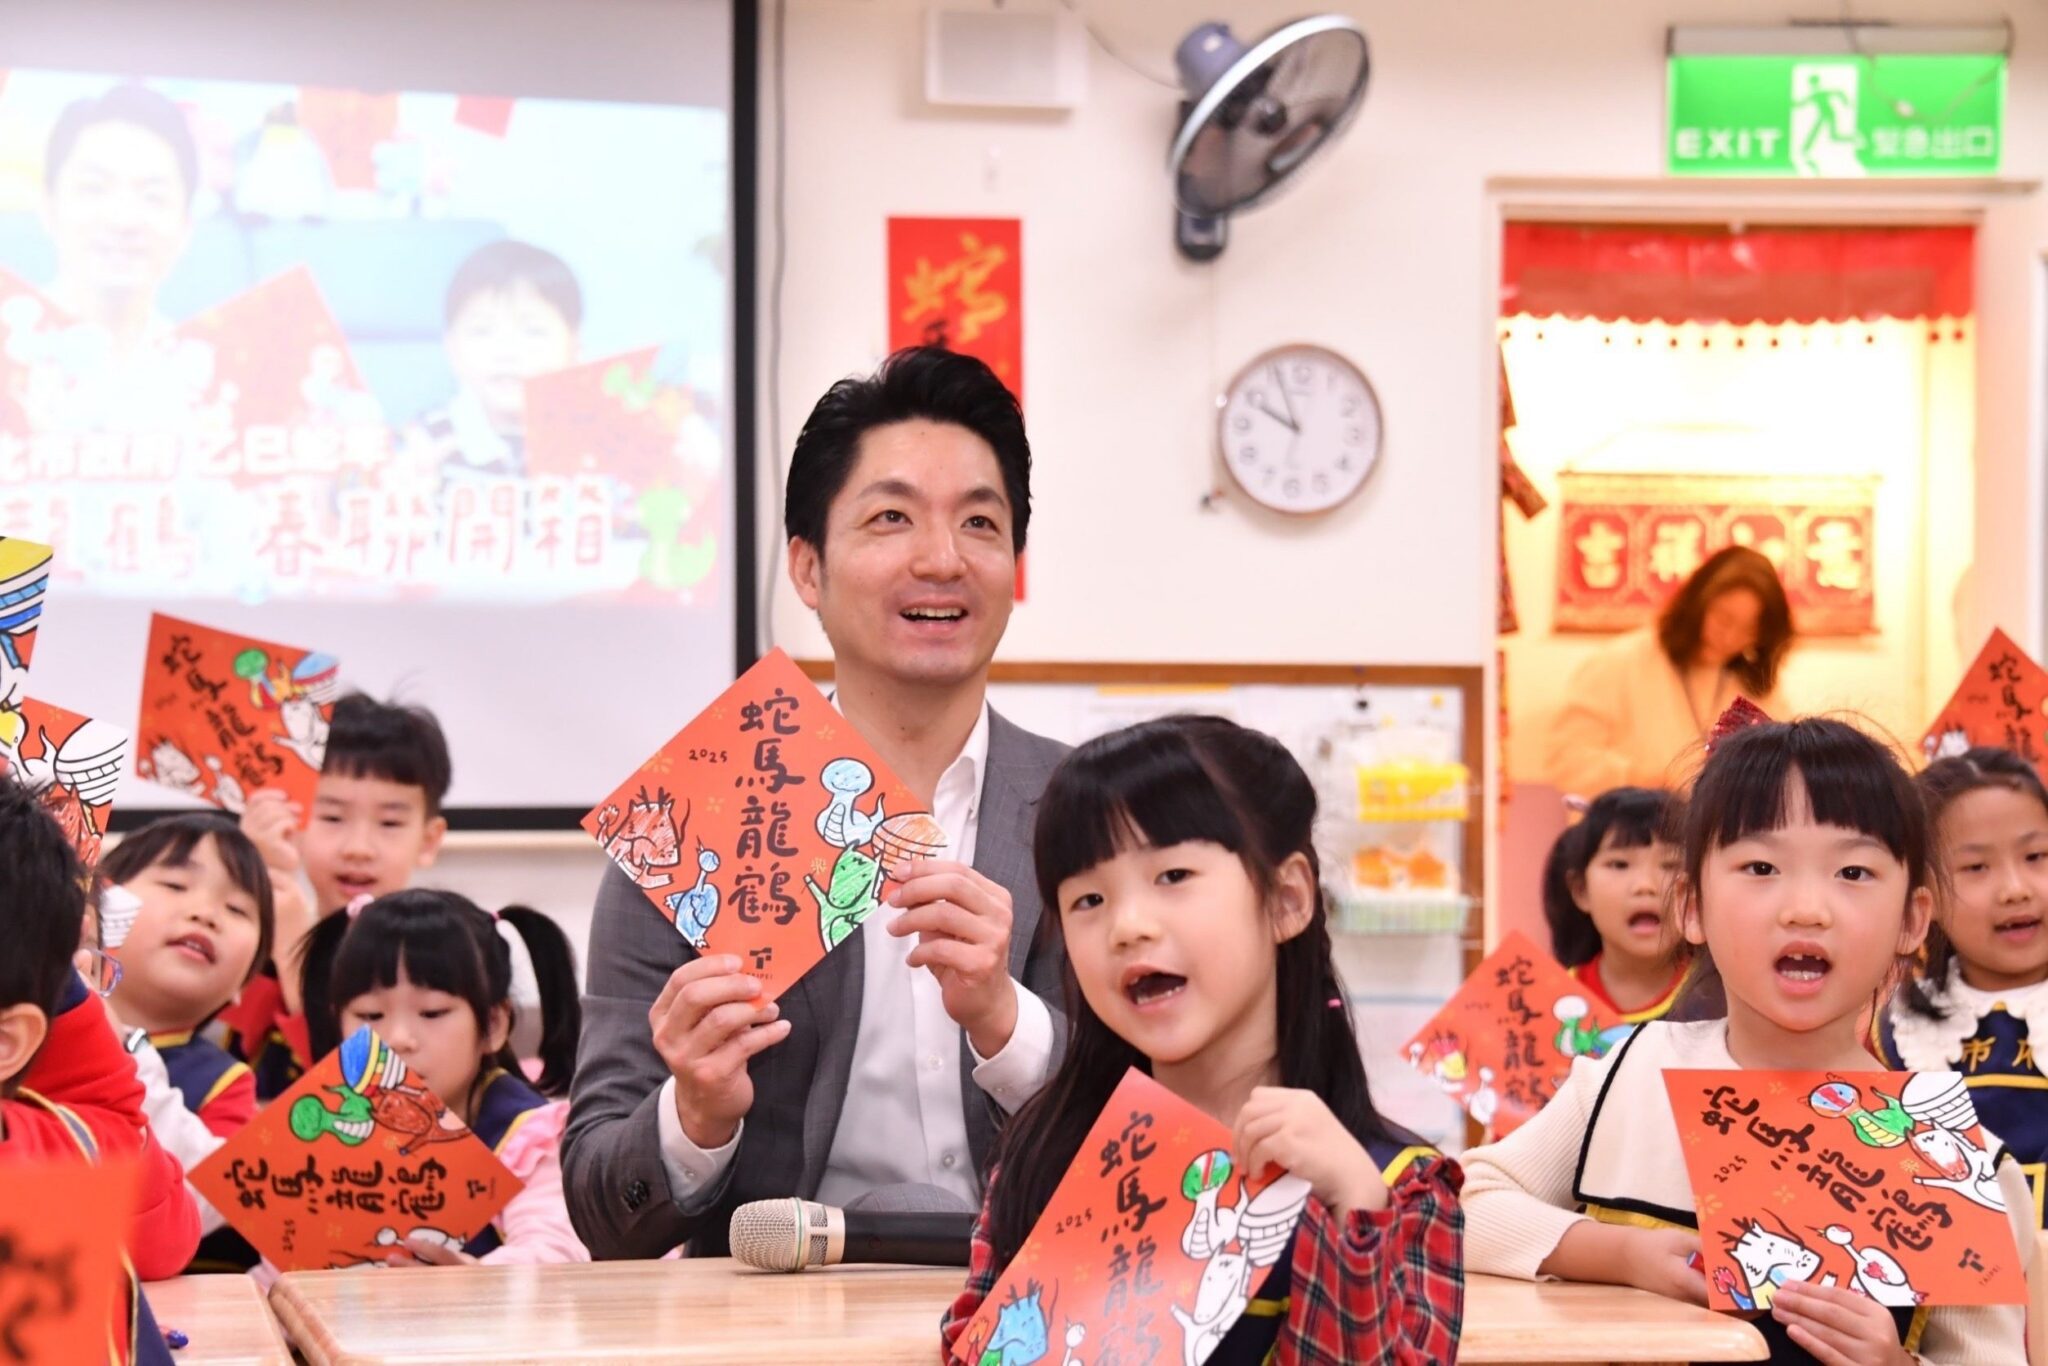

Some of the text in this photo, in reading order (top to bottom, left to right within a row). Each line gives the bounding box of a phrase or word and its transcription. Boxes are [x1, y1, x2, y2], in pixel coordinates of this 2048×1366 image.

[1675, 128, 1781, 159] EXIT
[689, 749, 728, 763] 2025
[728, 688, 805, 924] 蛇馬龍鶴
[1701, 1085, 1953, 1252] 蛇馬龍鶴
[1714, 1155, 1748, 1184] 2025
[224, 1154, 447, 1220] 蛇馬龍鶴
[1056, 1208, 1093, 1235] 2025
